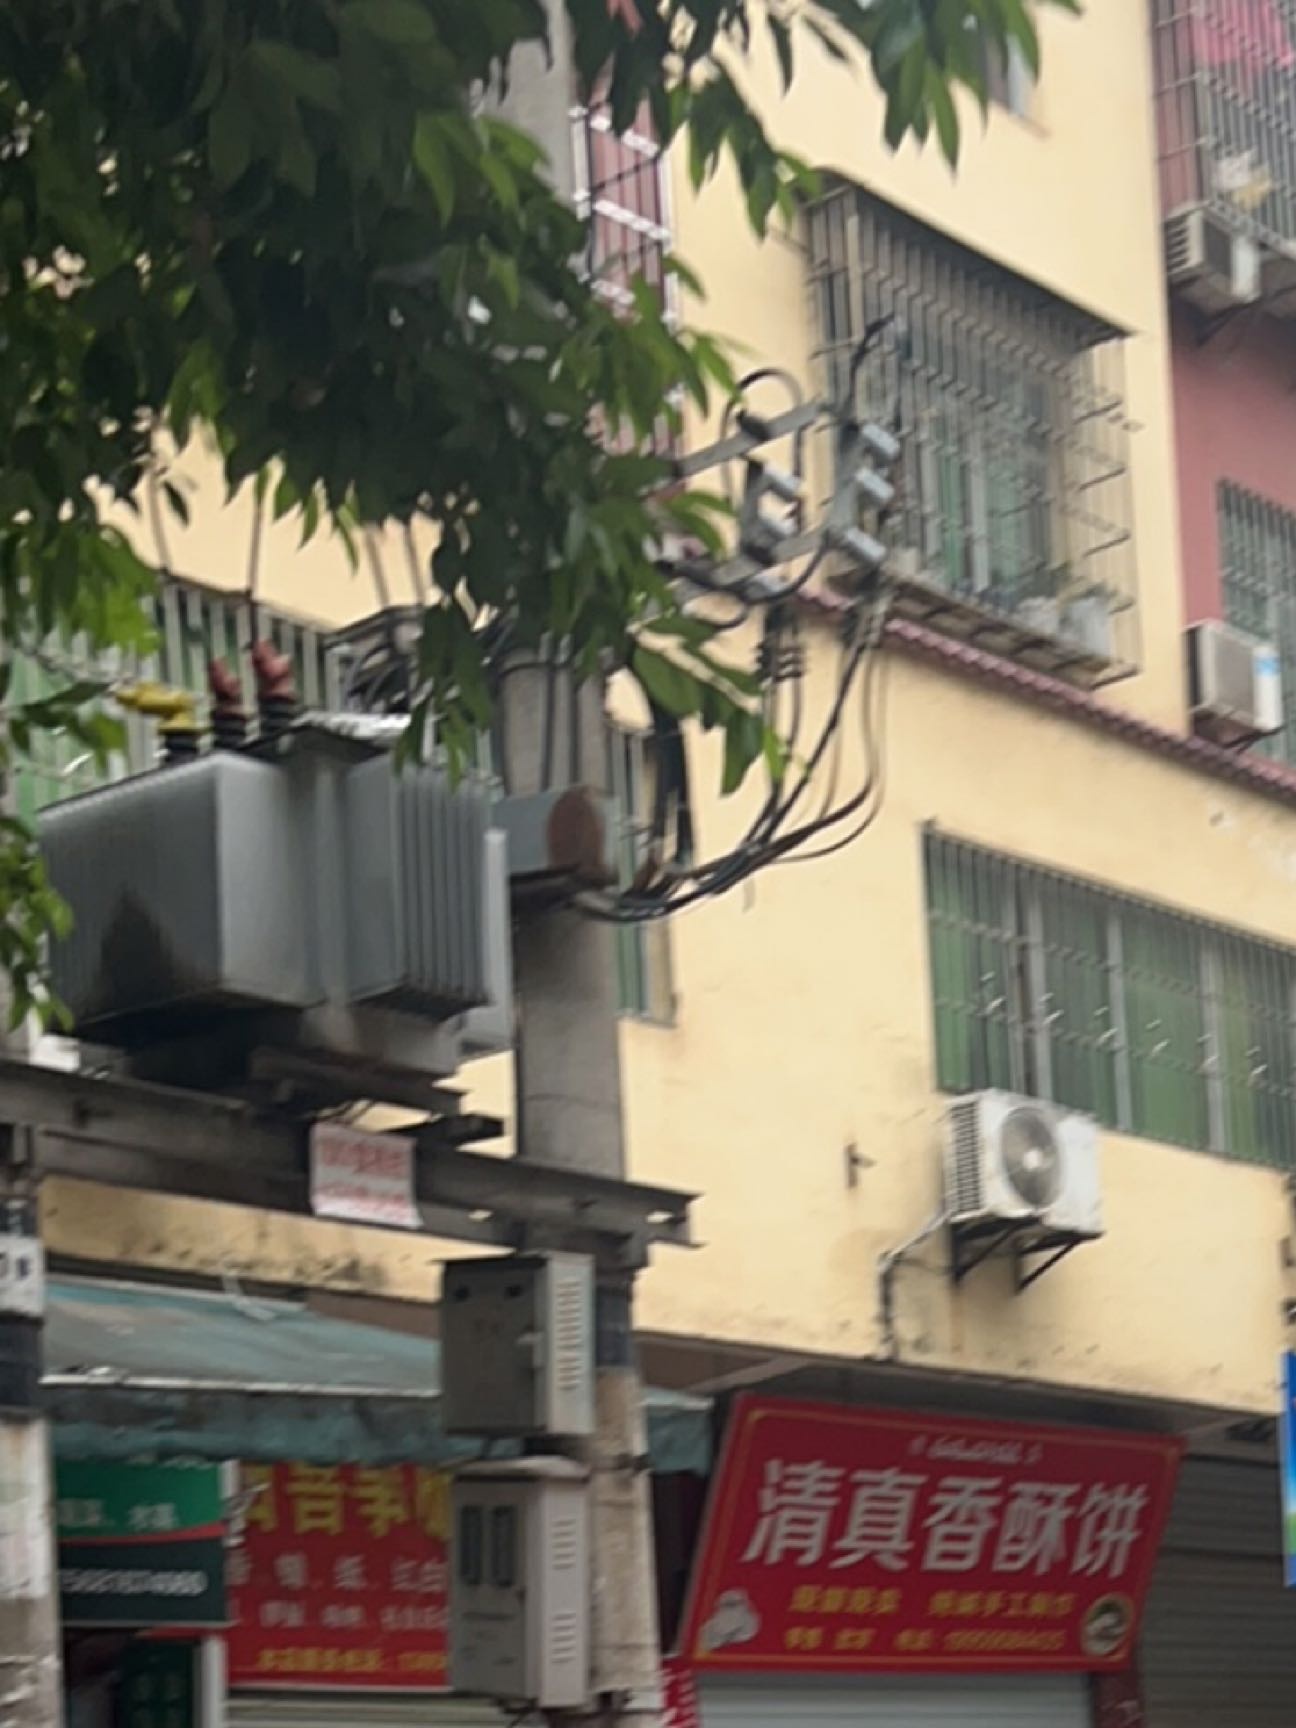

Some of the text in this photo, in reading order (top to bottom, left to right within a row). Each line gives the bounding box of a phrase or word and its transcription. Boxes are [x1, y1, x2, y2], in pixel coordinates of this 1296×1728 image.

[740, 1458, 1150, 1579] 清真香酥饼
